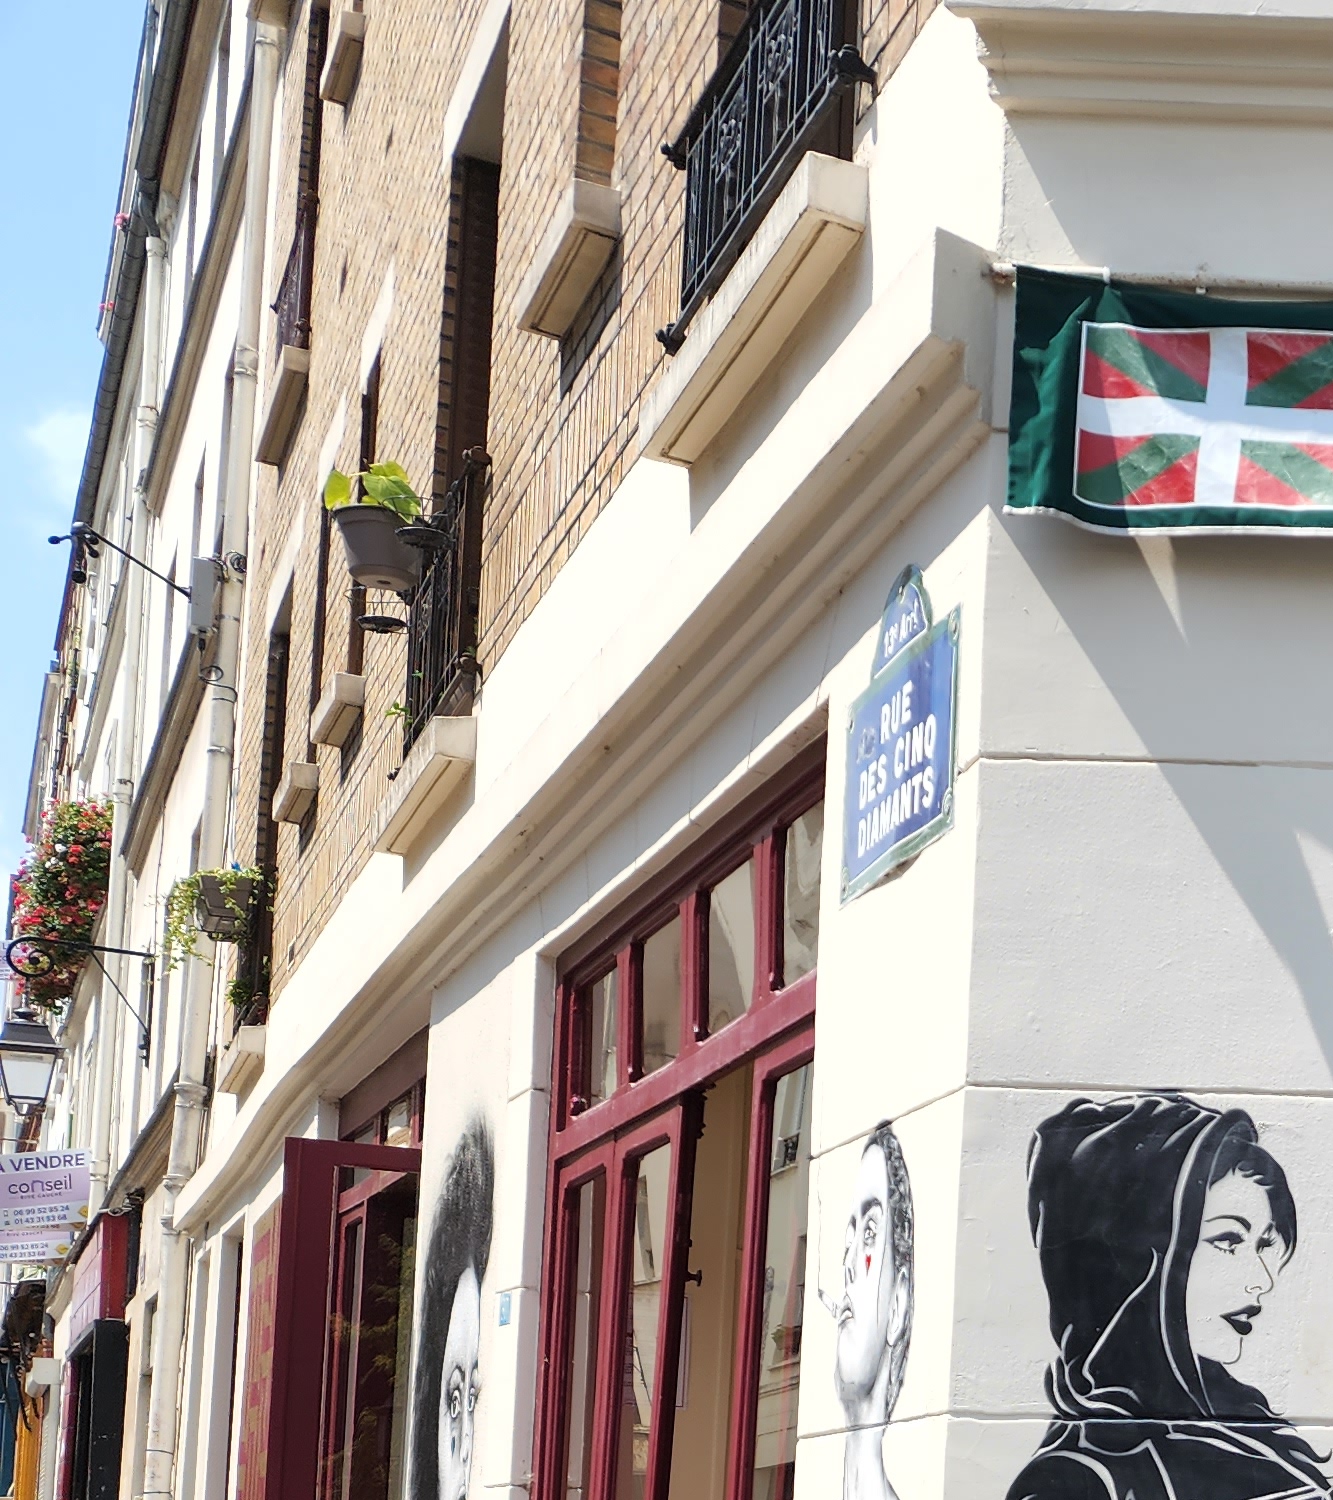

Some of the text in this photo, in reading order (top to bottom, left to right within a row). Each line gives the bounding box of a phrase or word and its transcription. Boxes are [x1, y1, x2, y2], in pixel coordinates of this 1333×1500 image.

[880, 680, 913, 745] RUE
[859, 713, 937, 811] DES CINQ
[857, 766, 935, 859] DIAMANTS
[8, 1173, 72, 1194] conseil
[9, 1153, 85, 1172] VENDRE
[60, 1204, 70, 1212] 24
